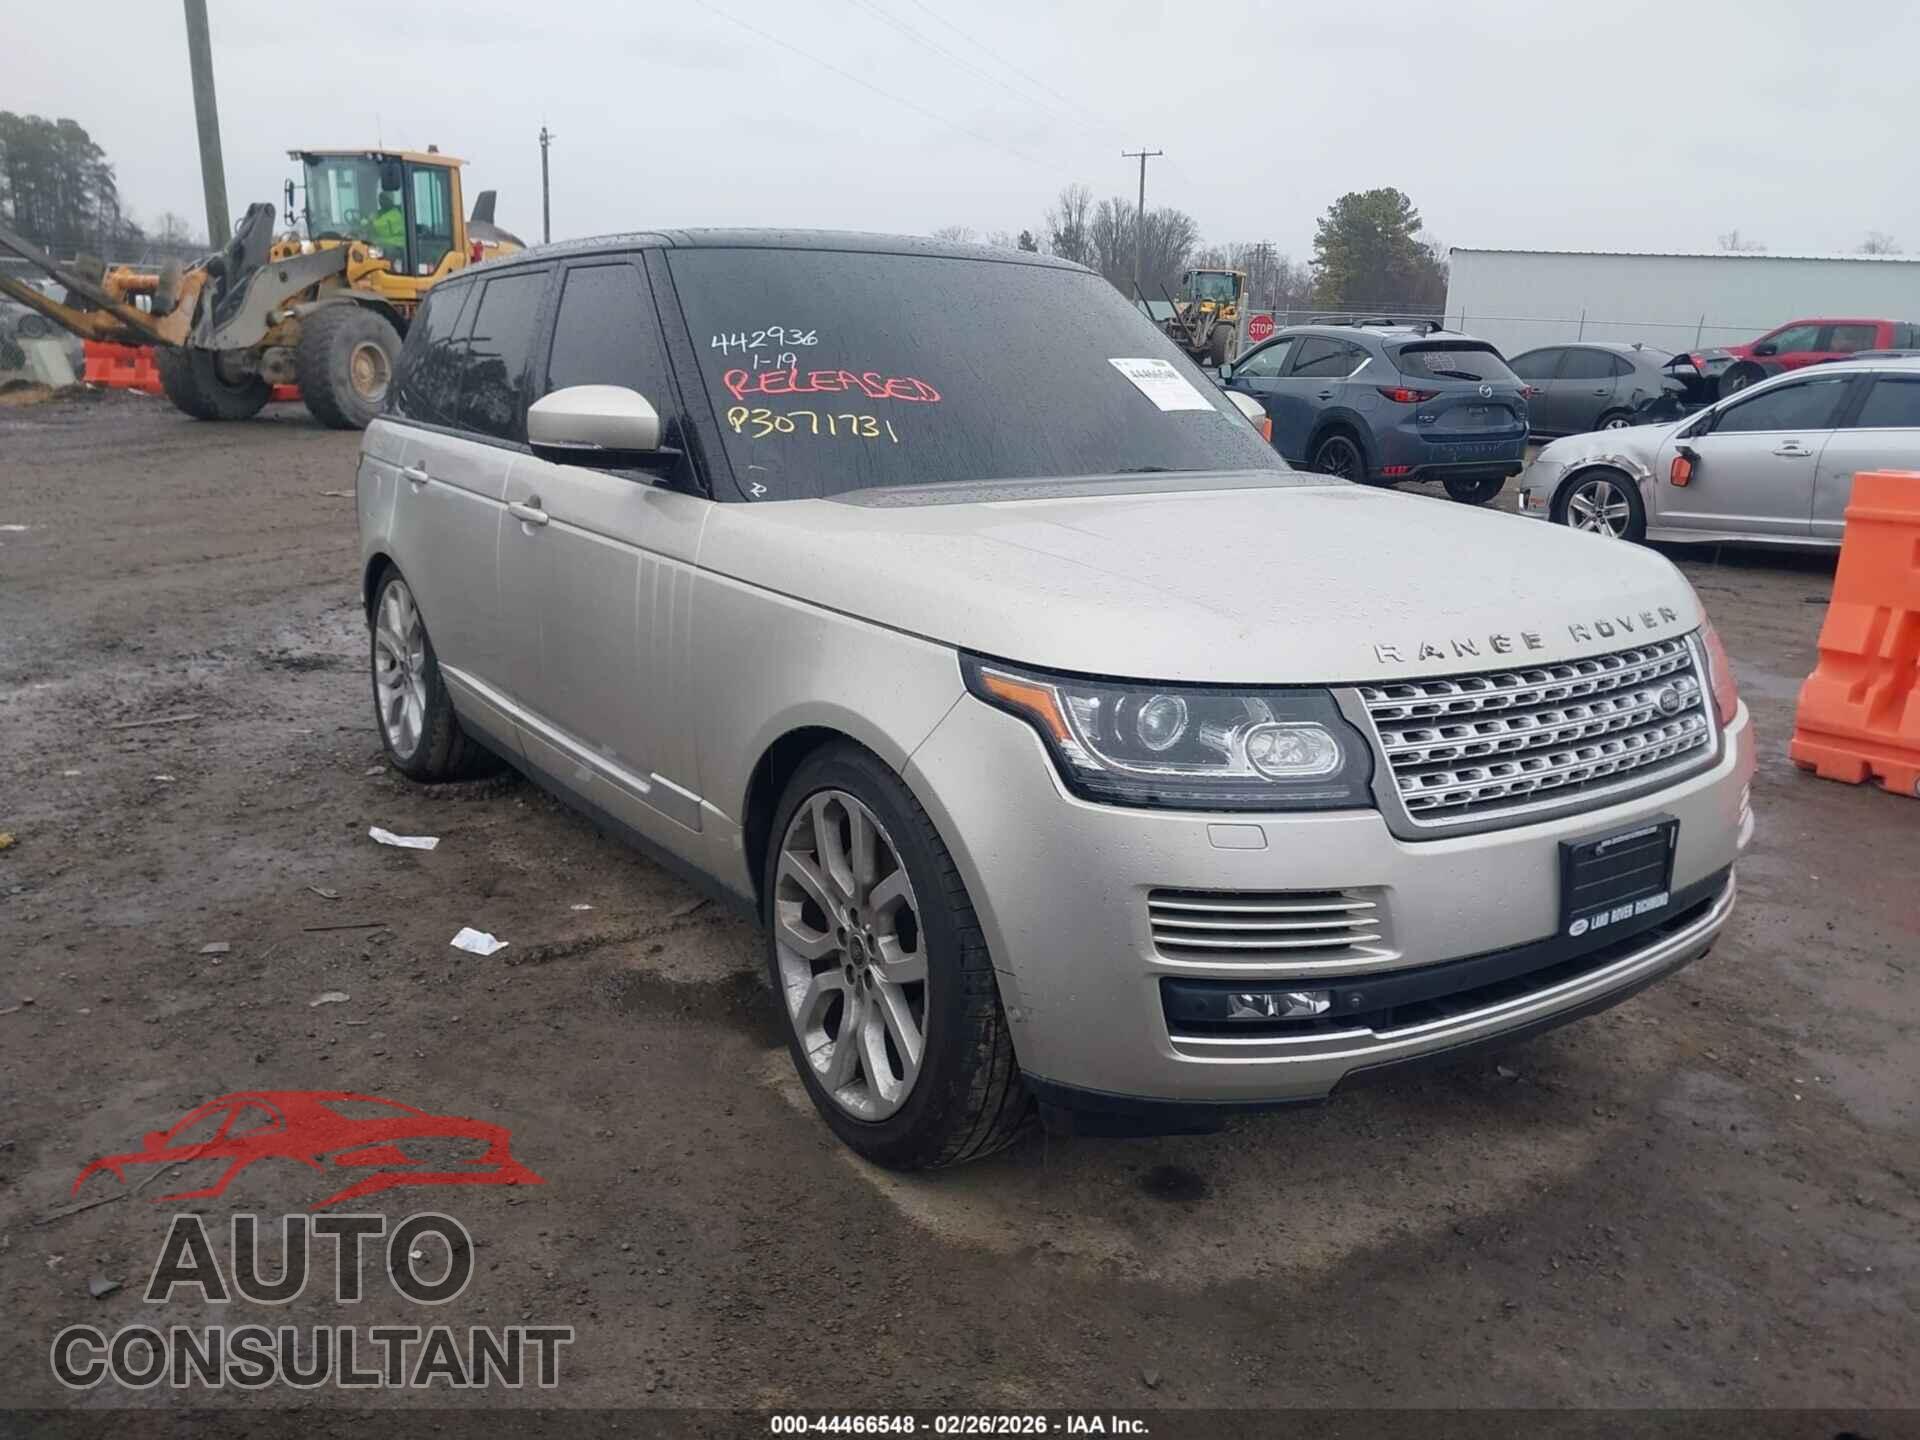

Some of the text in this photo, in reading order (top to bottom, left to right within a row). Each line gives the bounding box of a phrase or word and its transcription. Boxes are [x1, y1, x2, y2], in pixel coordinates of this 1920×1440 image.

[711, 326, 818, 356] 442936
[1250, 323, 1273, 334] STOP
[753, 352, 797, 369] 1-19
[723, 368, 941, 402] RELEASED
[1374, 606, 1679, 664] RANGE ROVER
